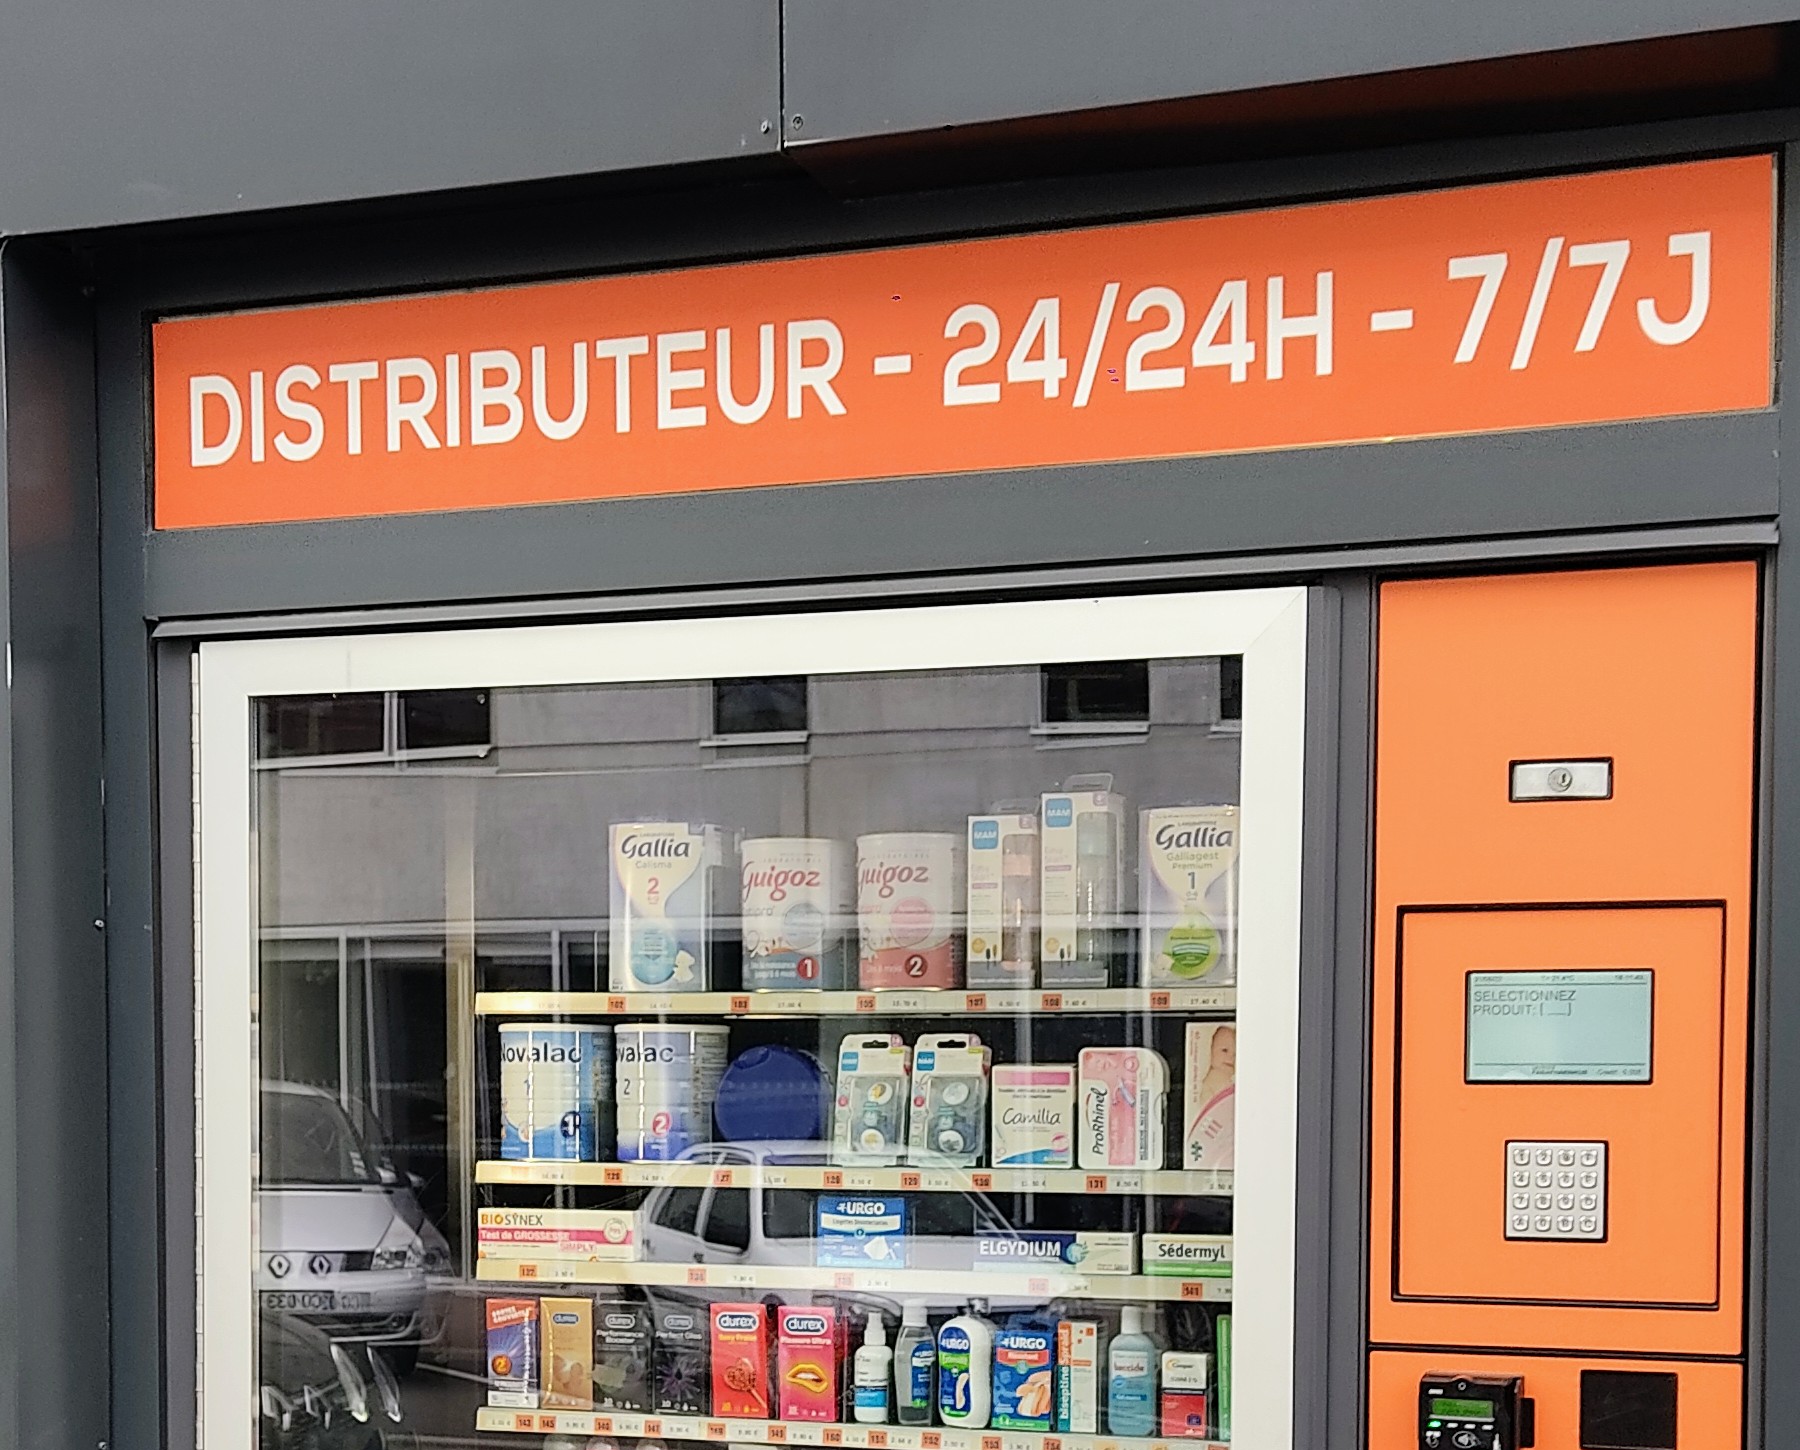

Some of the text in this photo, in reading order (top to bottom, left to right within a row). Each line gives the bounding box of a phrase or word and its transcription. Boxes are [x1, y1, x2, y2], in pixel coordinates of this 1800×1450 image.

[190, 319, 847, 467] DISTRIBUTEUR
[943, 270, 1334, 407] 24/24H
[1447, 231, 1712, 371] 7/7J
[1156, 824, 1233, 850] Gallia
[621, 835, 690, 859] Gallia
[647, 877, 659, 894] 2
[803, 959, 812, 977] 1
[909, 958, 923, 976] 2
[1474, 990, 1576, 1002] SELECTIONNEZ
[623, 1078, 632, 1095] 2
[655, 1115, 666, 1134] 2
[1002, 1107, 1061, 1126] Camilia
[1092, 1086, 1108, 1155] ProRhinel
[846, 1201, 886, 1215] URGO
[481, 1231, 500, 1241] Test
[501, 1231, 512, 1240] de
[980, 1240, 1061, 1257] ELGYDIUM
[1158, 1243, 1226, 1261] Sédermyl
[720, 1315, 755, 1328] durex
[788, 1318, 823, 1330] durex
[946, 1338, 969, 1351] URGO
[1011, 1337, 1046, 1350] URGO
